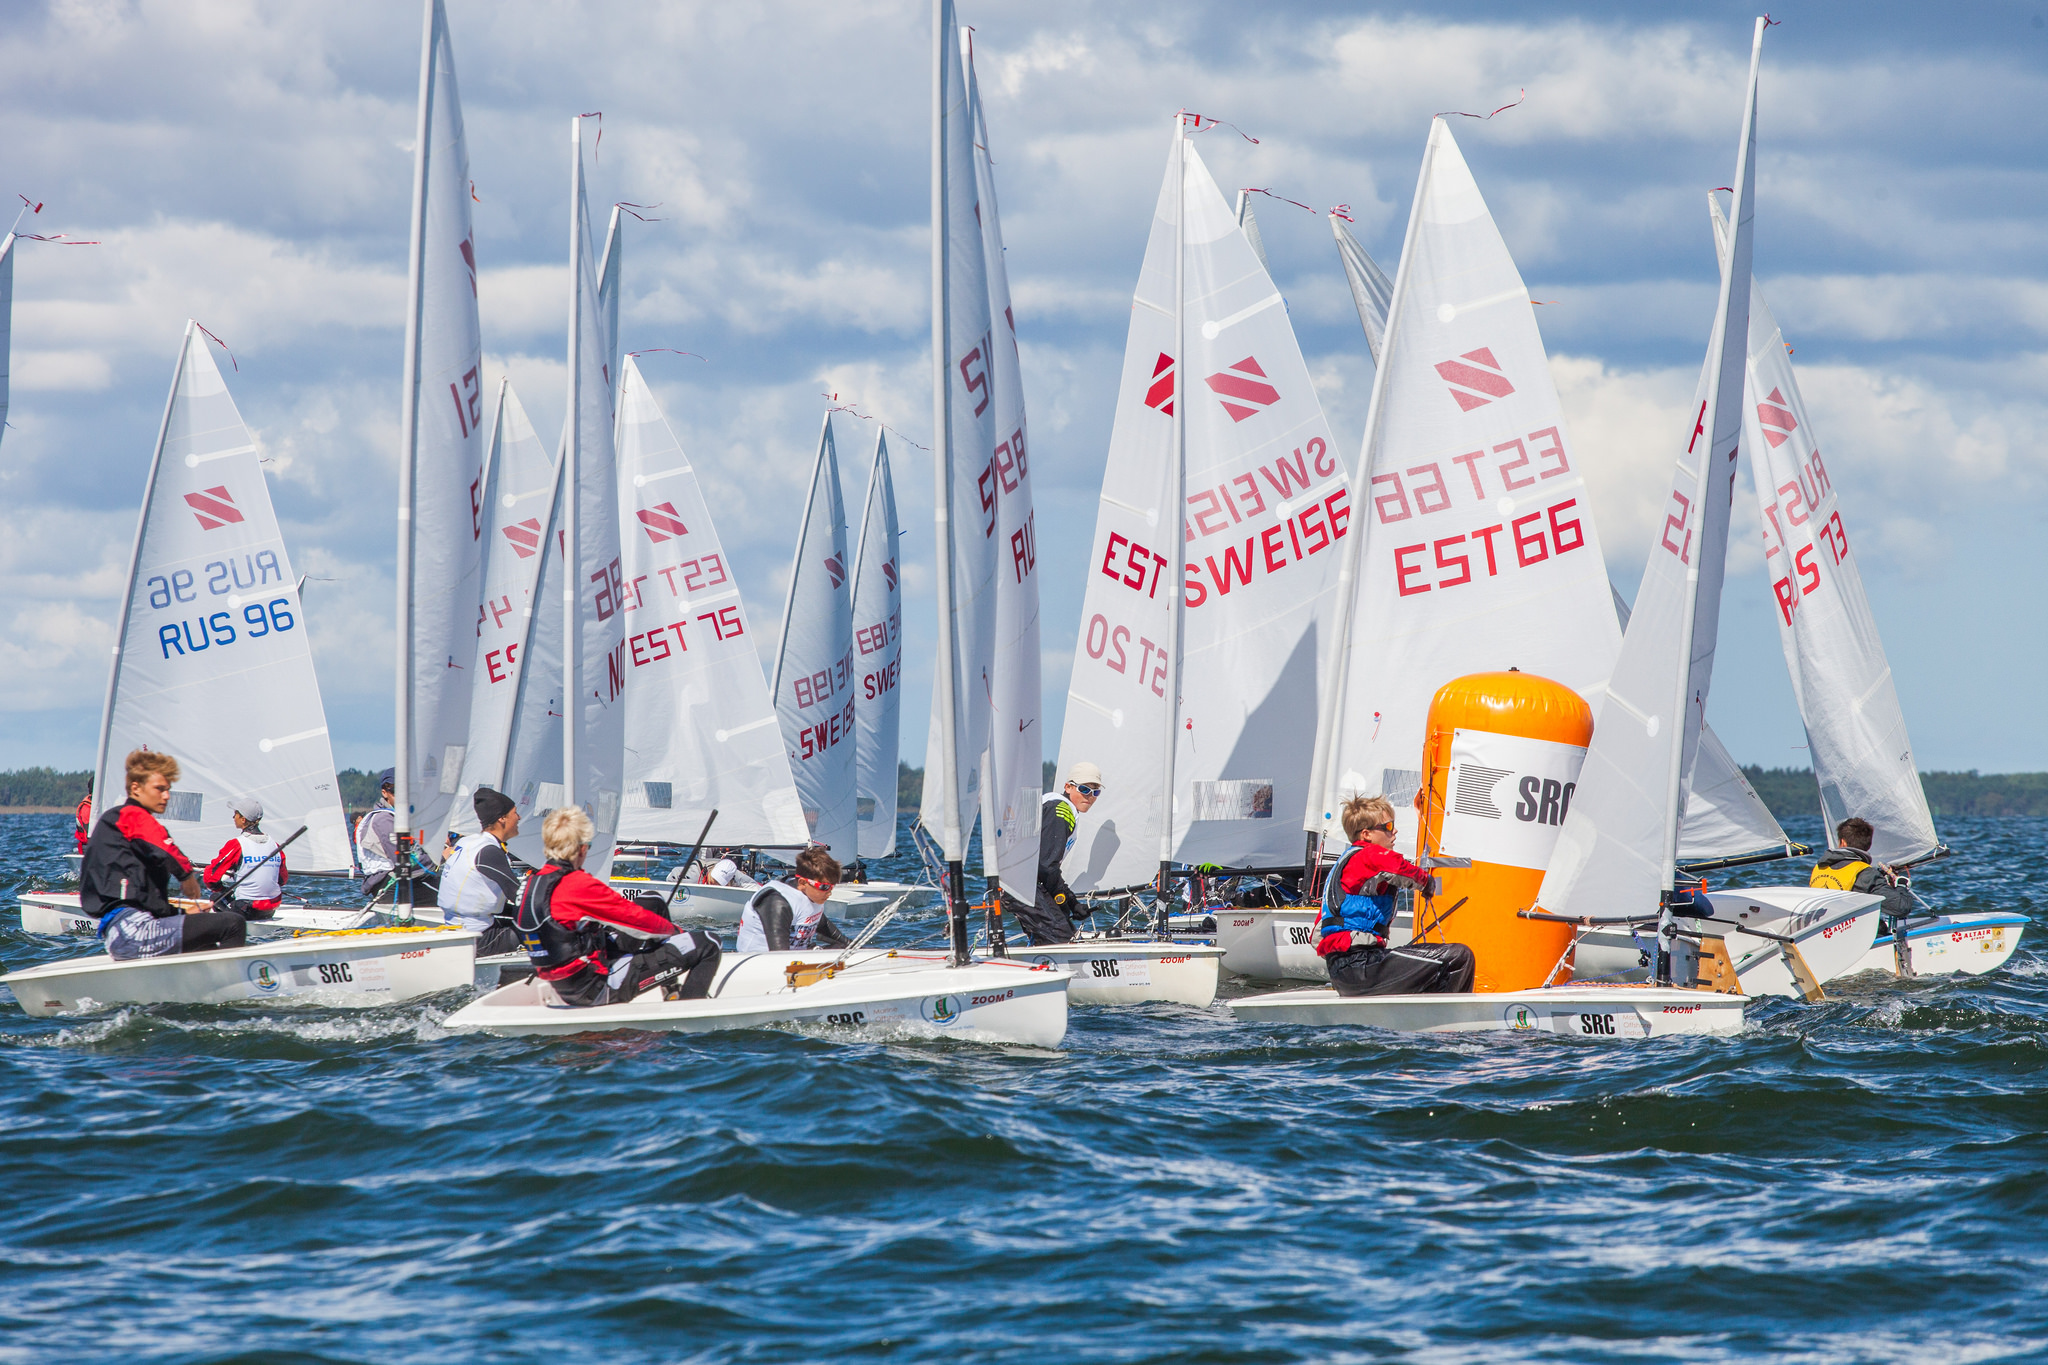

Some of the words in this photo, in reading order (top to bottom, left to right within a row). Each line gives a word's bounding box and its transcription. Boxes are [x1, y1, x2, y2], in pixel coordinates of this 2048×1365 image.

[1819, 510, 1848, 567] 73
[1102, 531, 1167, 599] EST
[159, 612, 236, 659] RUS
[243, 598, 294, 638] 96
[697, 605, 744, 641] 75
[629, 621, 687, 667] EST
[864, 660, 896, 700] SWE
[800, 713, 839, 760] SWE
[1834, 917, 1856, 933] ALTAIR
[1964, 929, 1991, 939] ALTAIR
[318, 962, 353, 984] SRC
[1091, 959, 1120, 978] SRC
[1580, 1013, 1615, 1035] SRC
